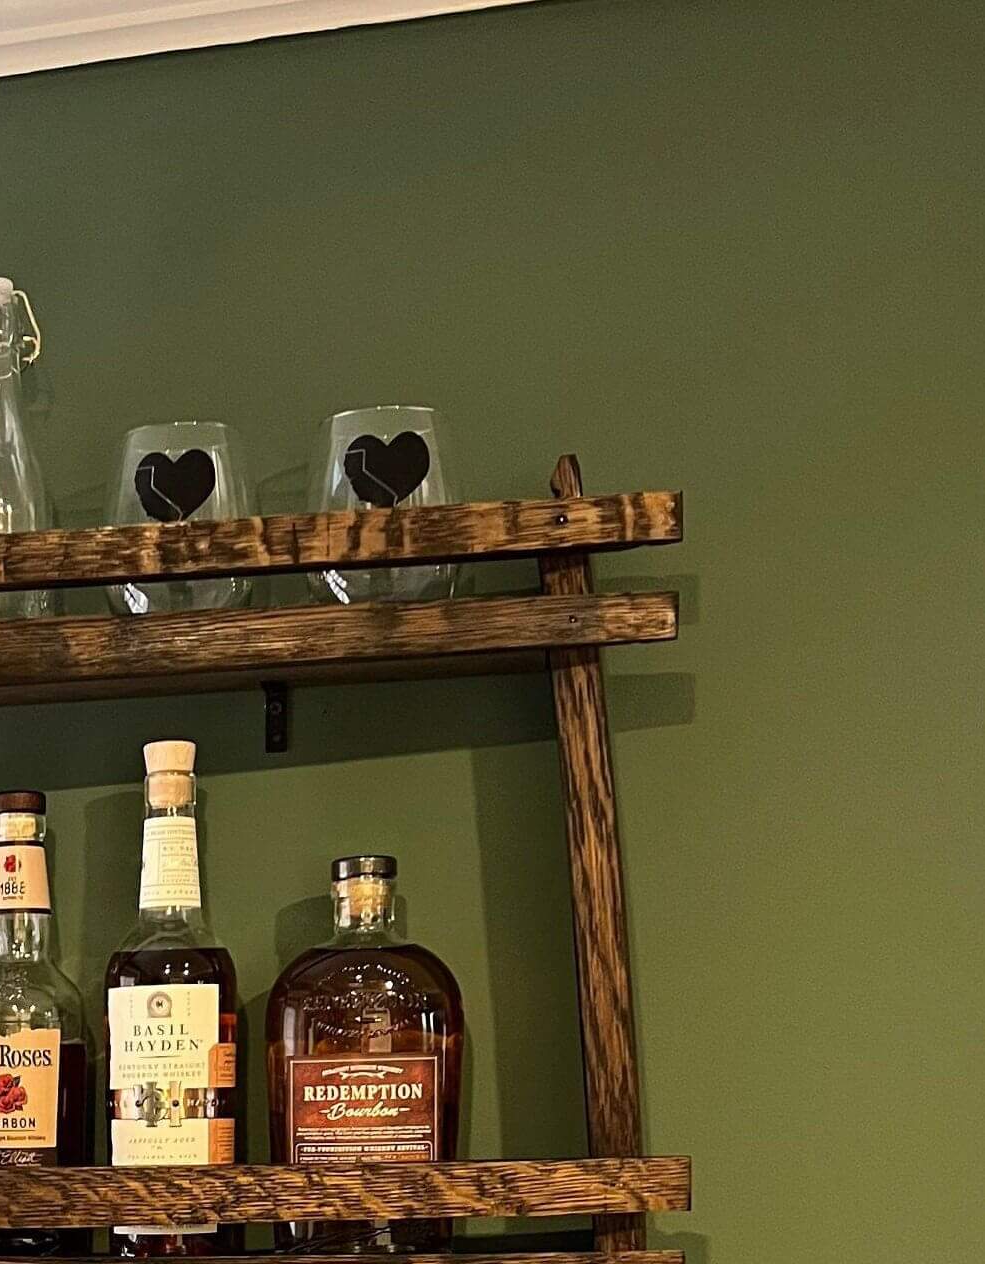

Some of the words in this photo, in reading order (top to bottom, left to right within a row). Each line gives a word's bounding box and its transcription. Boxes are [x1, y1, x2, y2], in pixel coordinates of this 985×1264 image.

[133, 1024, 189, 1037] BASIL
[124, 1039, 200, 1053] HAYDEN
[303, 1083, 423, 1102] REDEMPTION
[326, 1101, 399, 1121] Bourbon
